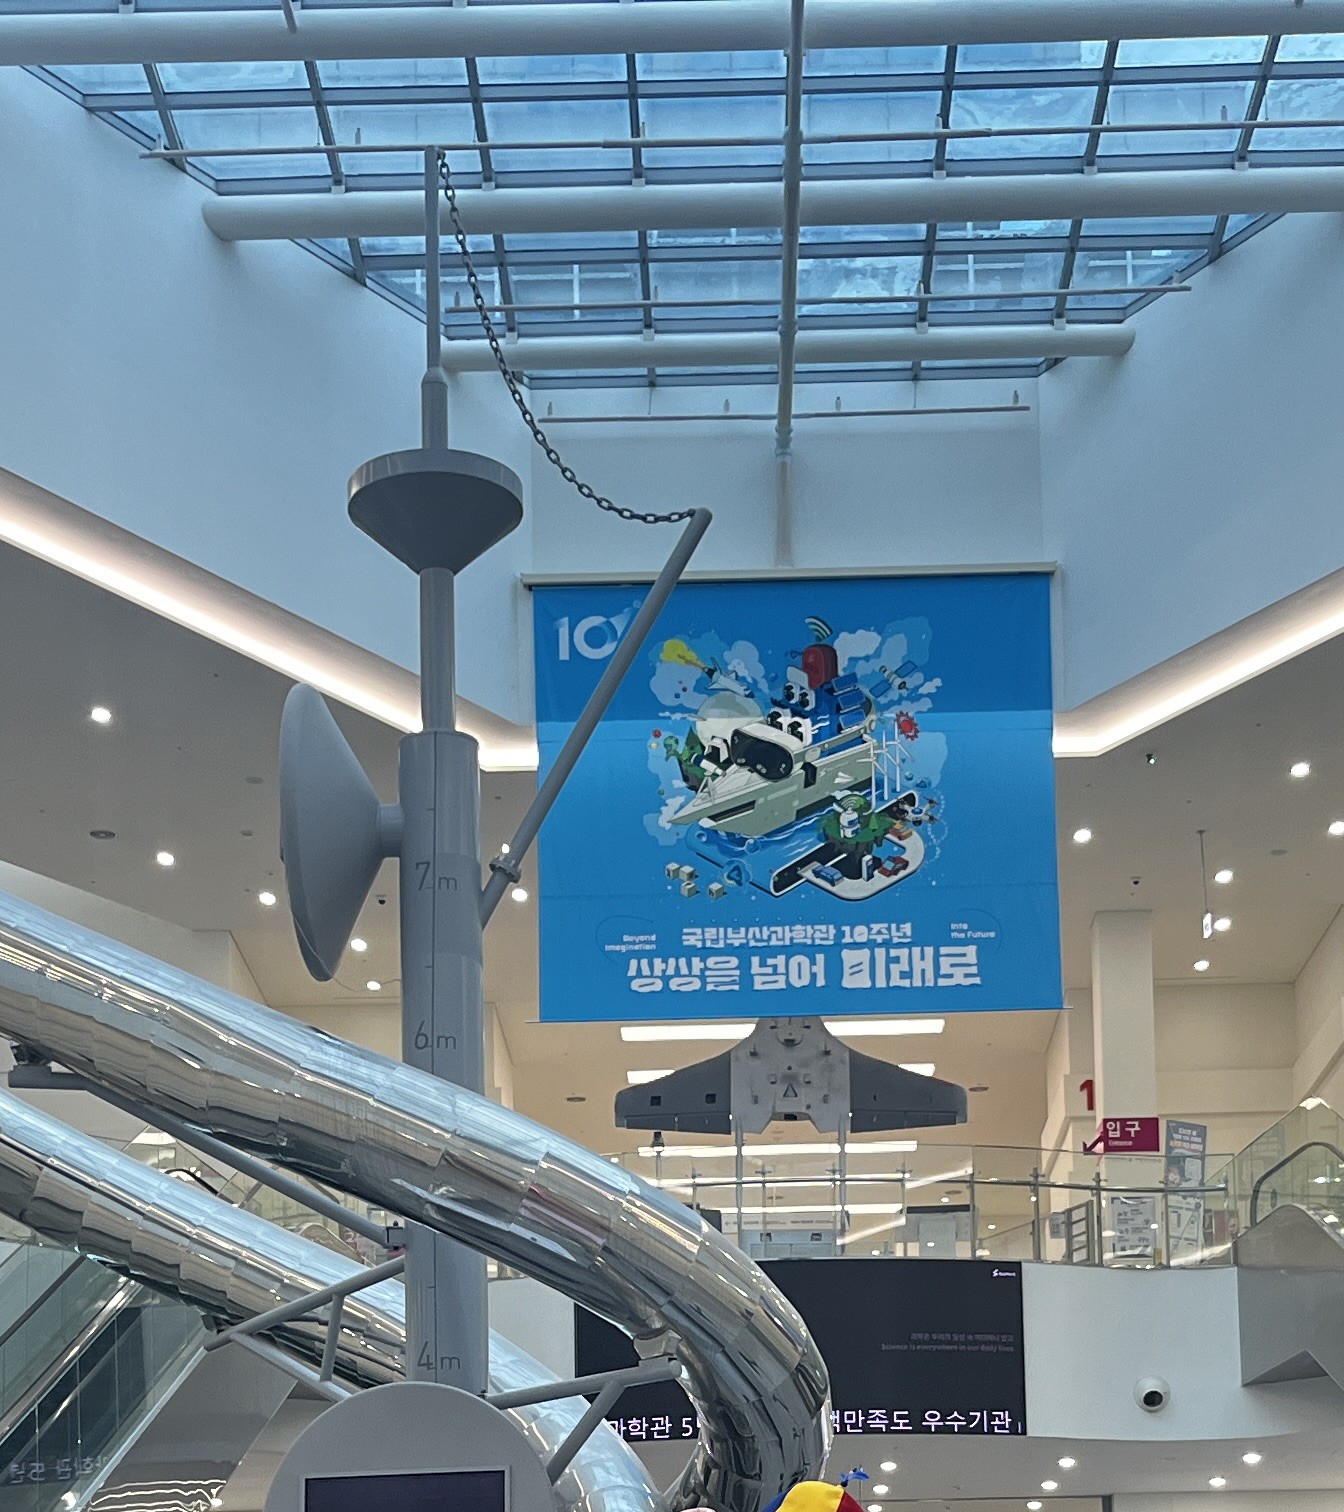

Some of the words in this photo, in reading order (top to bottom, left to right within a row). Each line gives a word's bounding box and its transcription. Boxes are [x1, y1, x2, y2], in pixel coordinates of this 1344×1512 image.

[556, 615, 620, 661] 10
[622, 934, 656, 944] Beyond
[681, 925, 837, 948] 국립부산과학관
[841, 922, 913, 945] 10주년
[627, 955, 740, 993] 상상을
[750, 953, 825, 990] 넘어
[840, 945, 981, 989] 미래로
[1079, 1079, 1095, 1112] 1
[1106, 1120, 1141, 1139] 입구
[922, 1409, 1012, 1434] 우수기관
